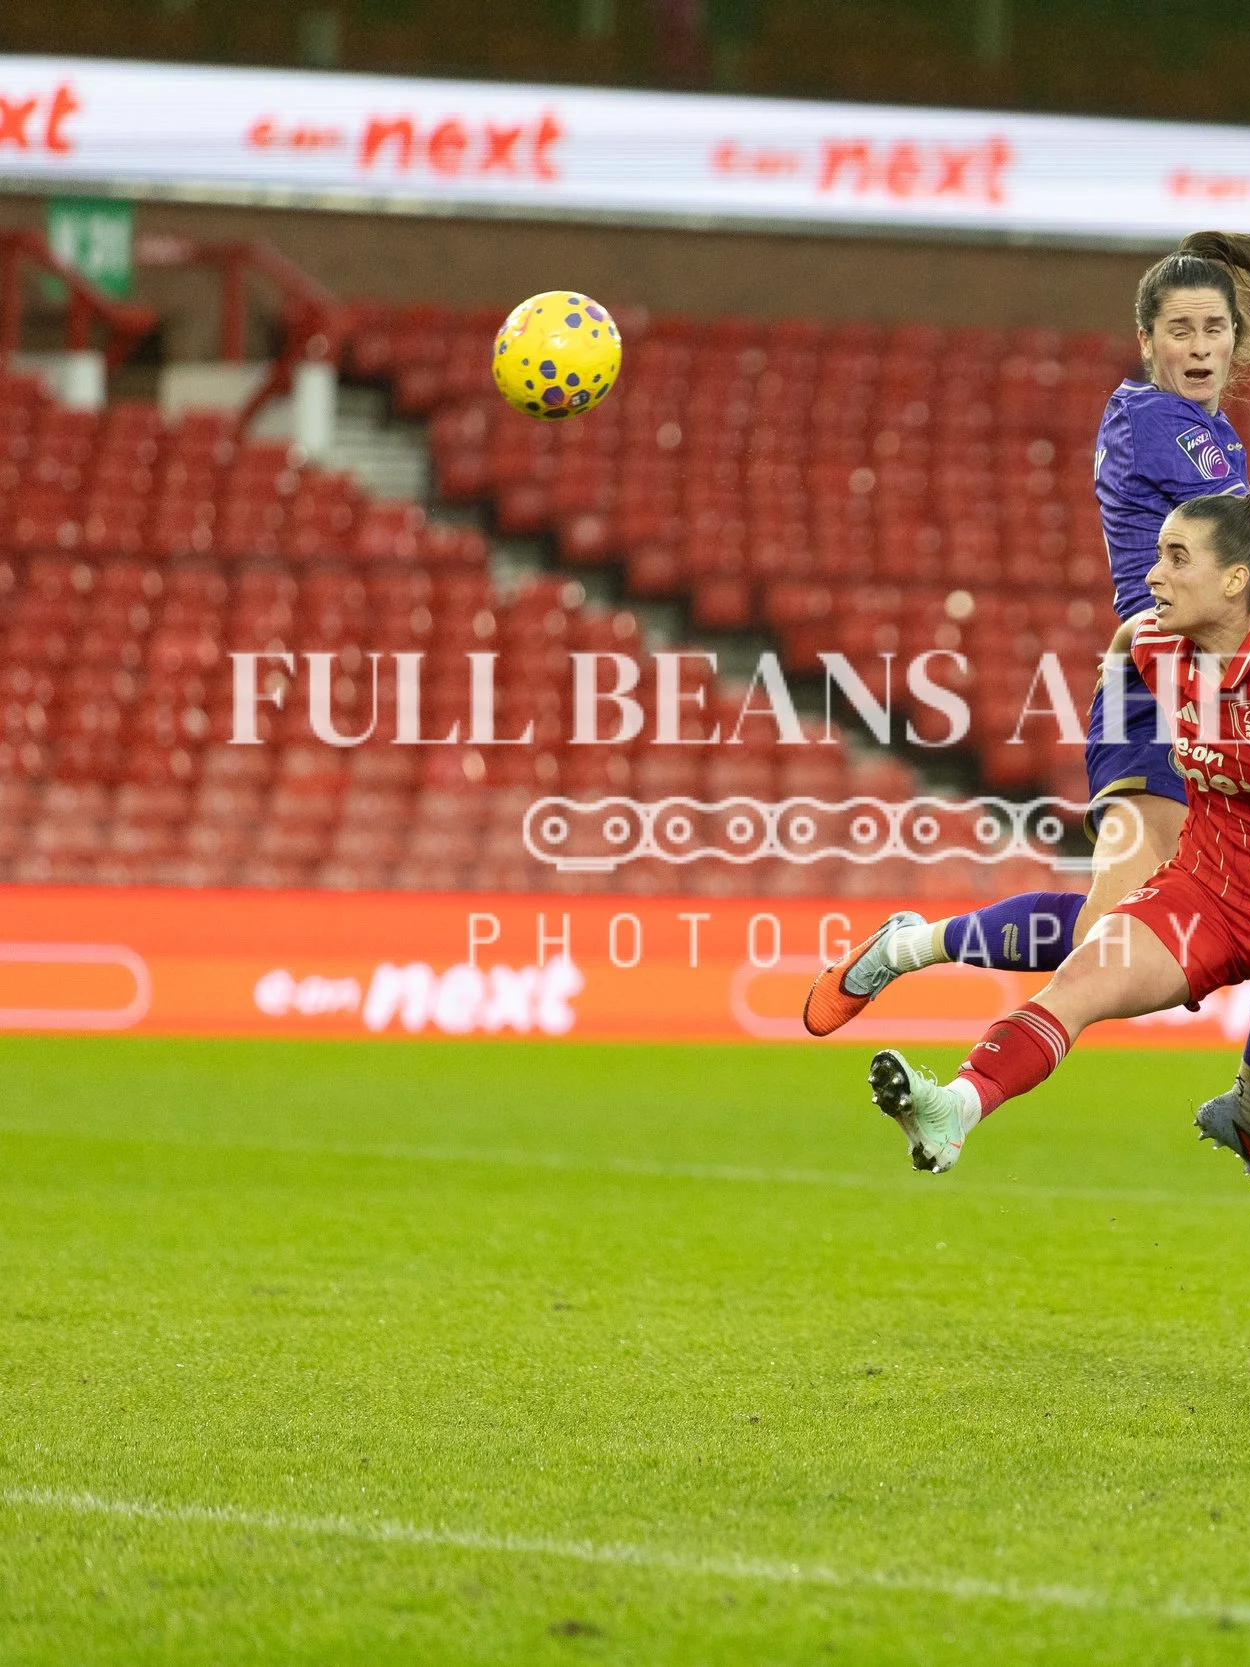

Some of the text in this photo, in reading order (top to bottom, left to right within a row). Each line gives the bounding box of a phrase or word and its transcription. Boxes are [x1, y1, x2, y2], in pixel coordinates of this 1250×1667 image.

[0, 83, 80, 156] xt
[356, 104, 565, 183] next
[816, 134, 1010, 204] next
[362, 955, 586, 1036] next
